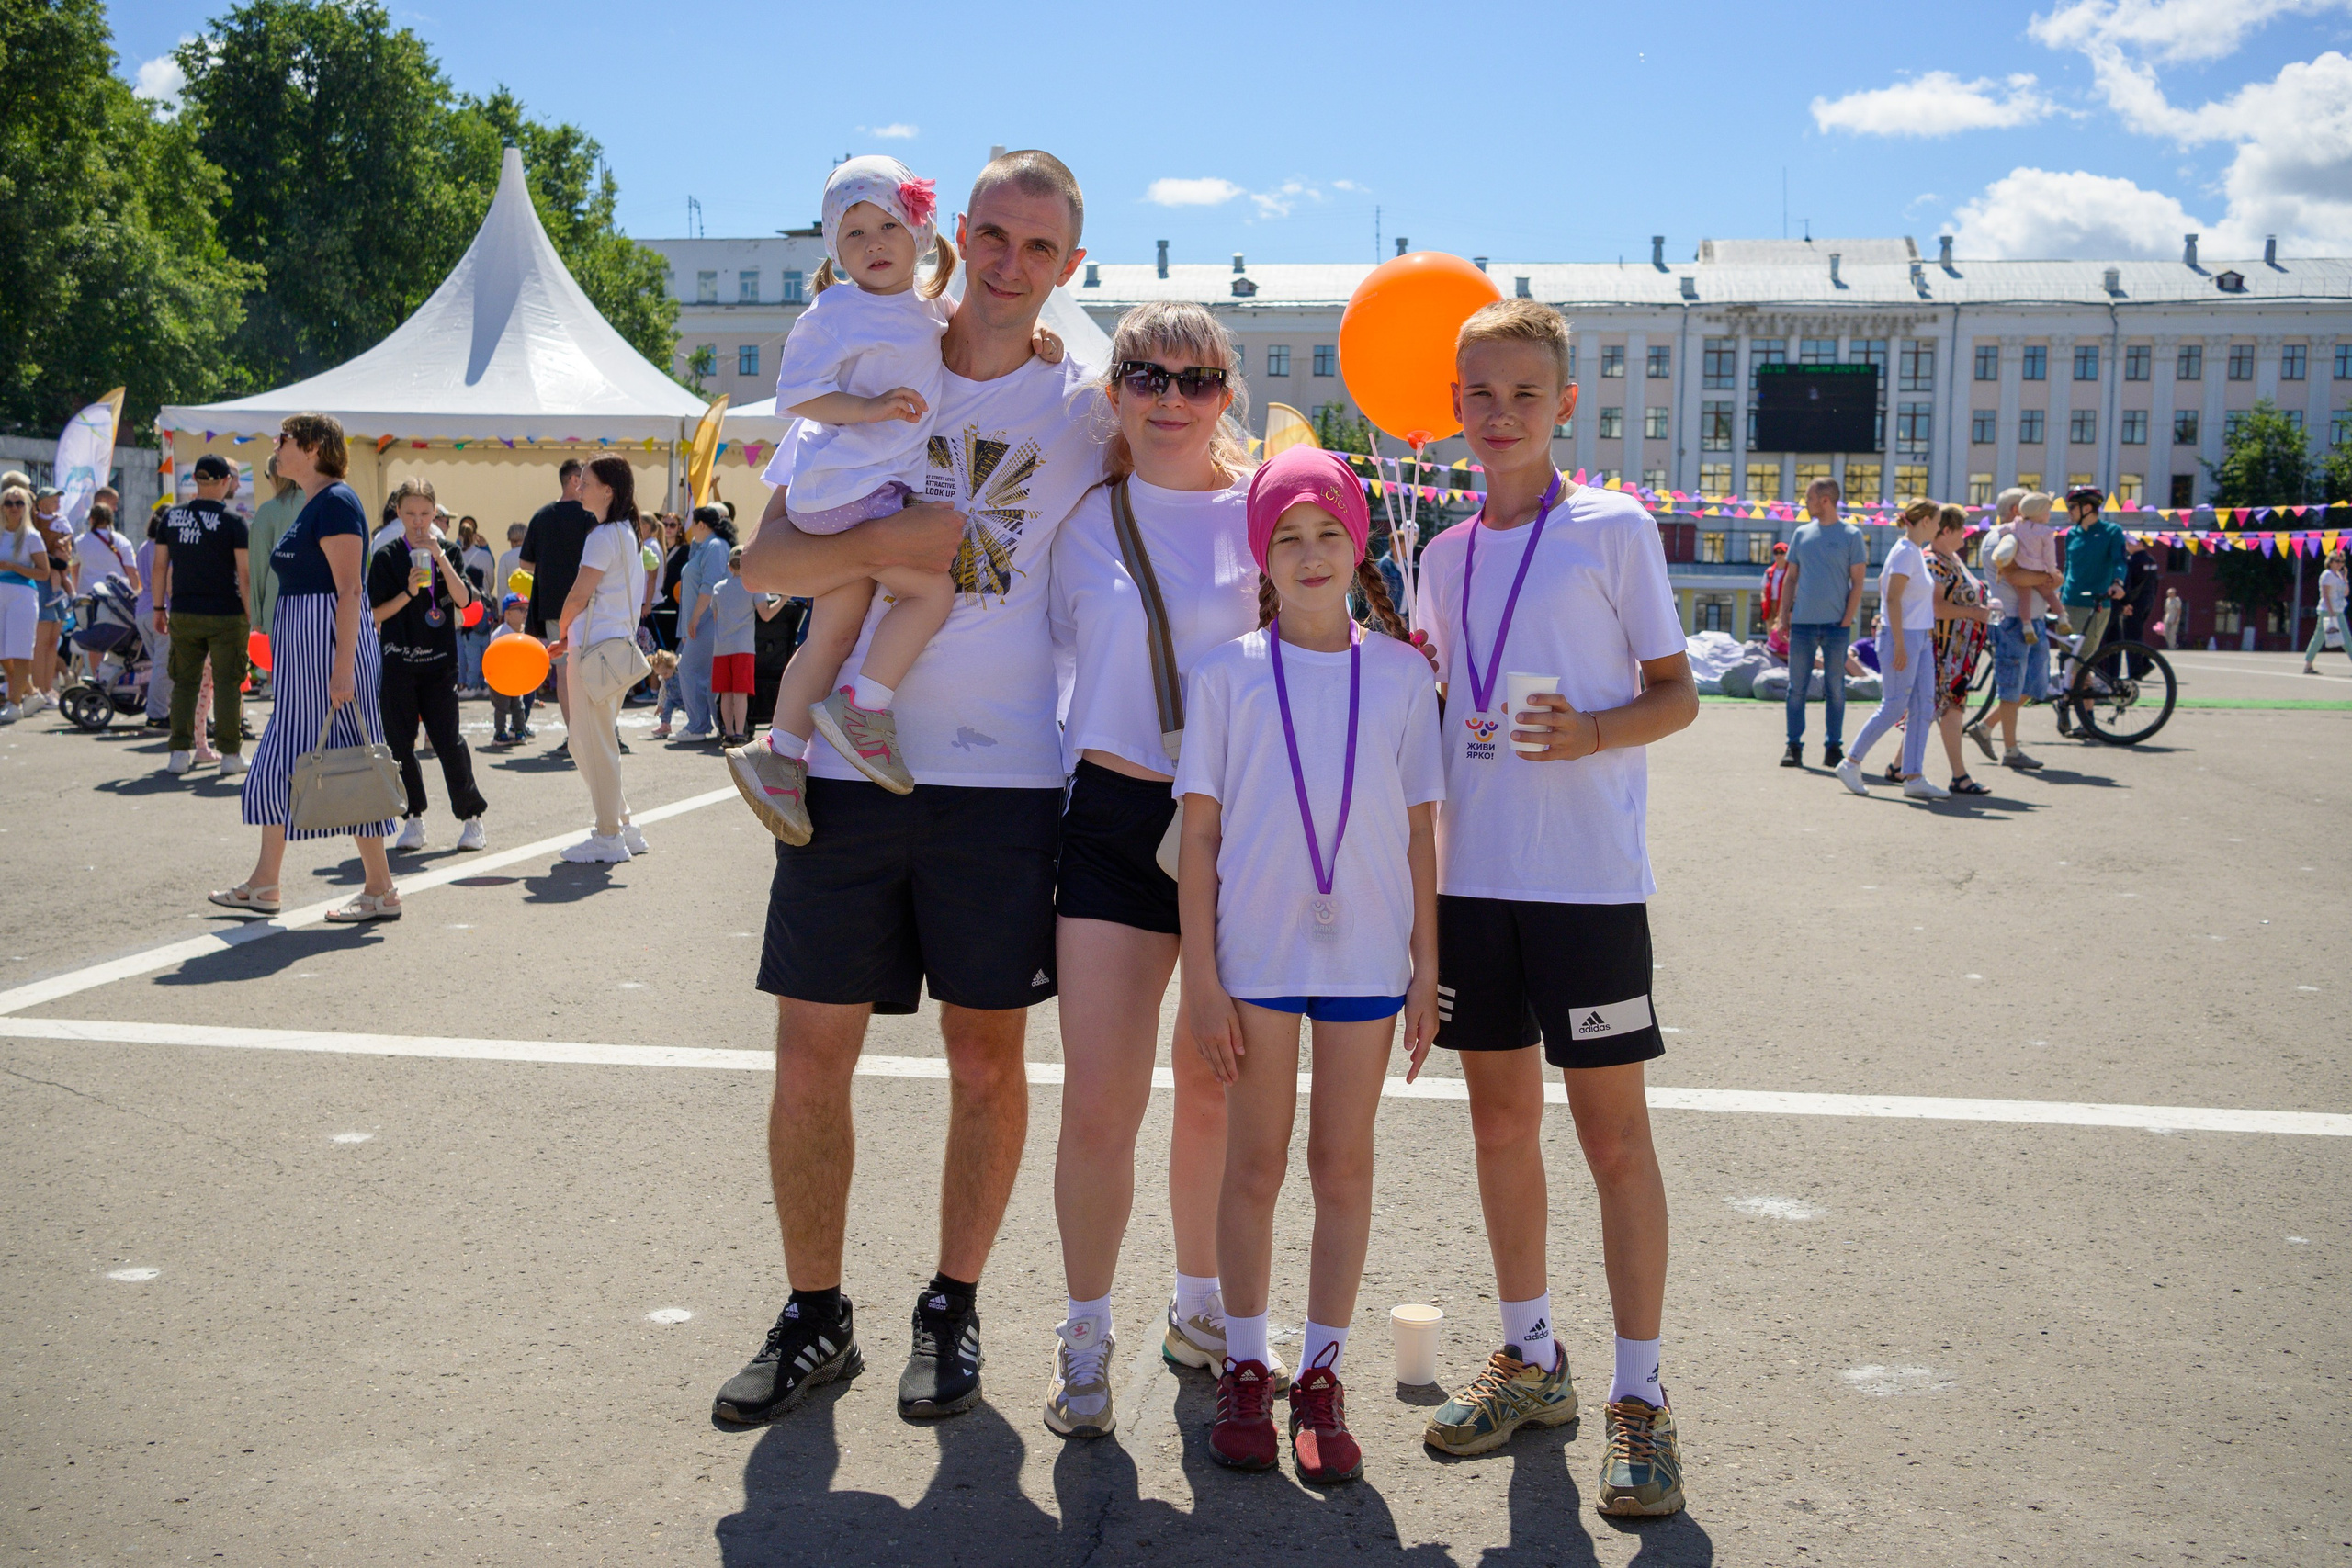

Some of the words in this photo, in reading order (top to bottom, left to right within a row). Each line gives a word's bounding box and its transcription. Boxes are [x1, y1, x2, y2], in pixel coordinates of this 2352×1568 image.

[926, 480, 956, 490] ATTRACTIVE.
[925, 487, 944, 497] LOOK
[945, 490, 956, 498] UP
[1466, 742, 1496, 751] ЖИВИ
[1465, 751, 1494, 760] ЯРКО!
[1031, 976, 1050, 987] adidas
[1579, 1024, 1611, 1033] adidas
[928, 1303, 946, 1311] adidas
[1524, 1330, 1549, 1341] adida
